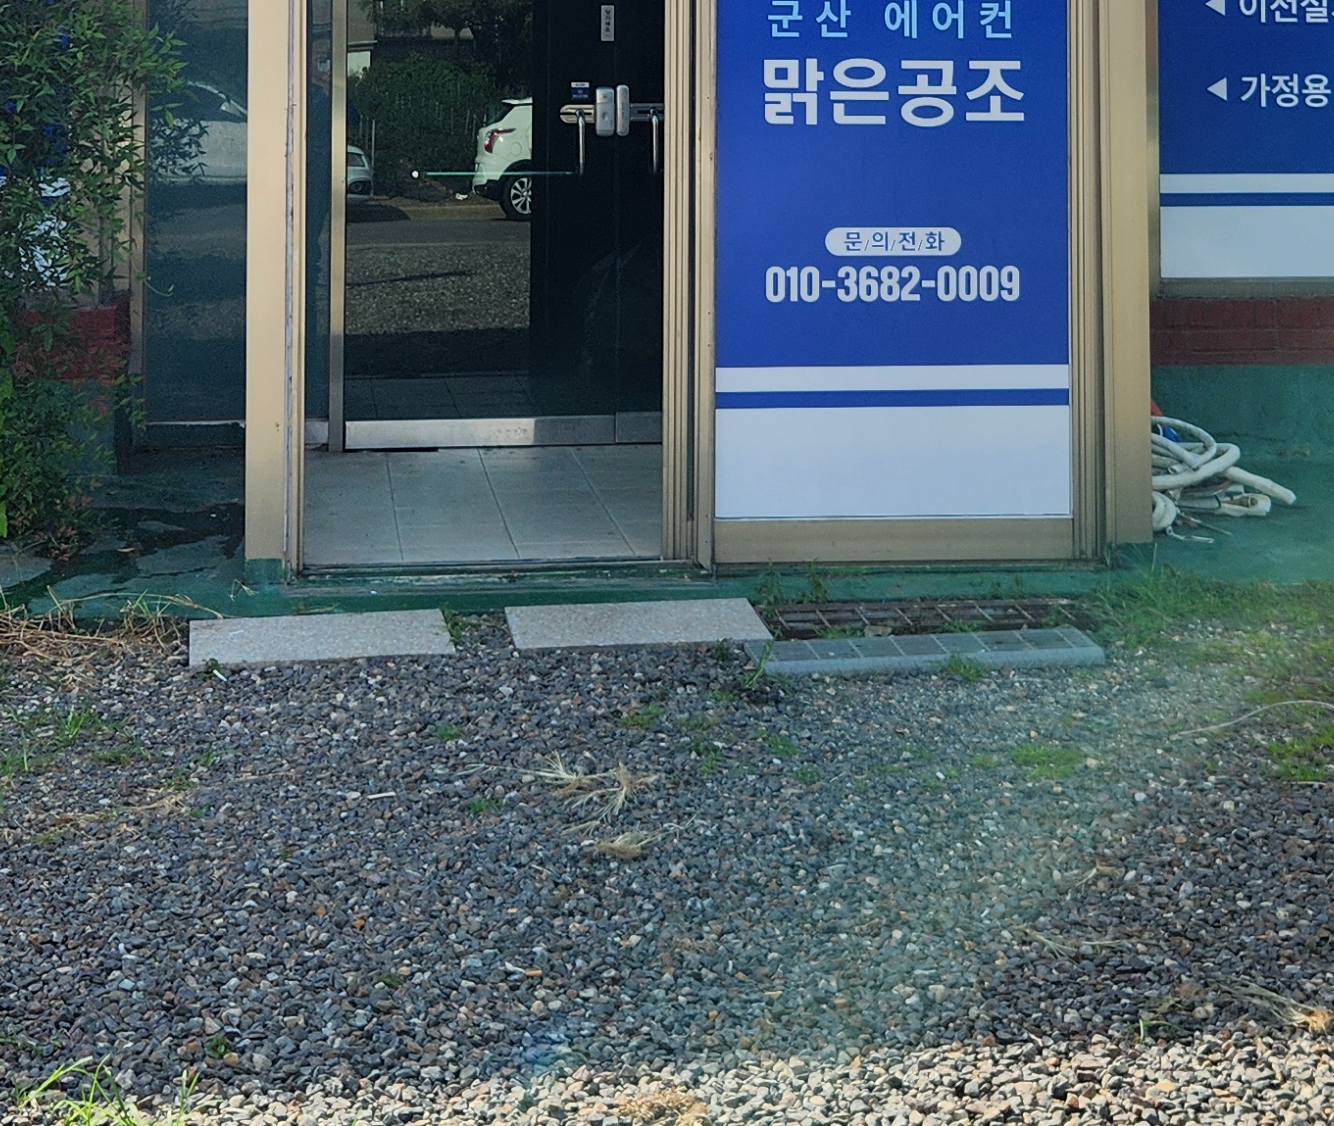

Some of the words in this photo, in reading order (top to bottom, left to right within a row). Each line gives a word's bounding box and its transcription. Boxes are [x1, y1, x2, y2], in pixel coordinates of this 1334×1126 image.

[767, 0, 852, 38] 군산
[884, 0, 1013, 39] 에어컨
[763, 58, 1024, 127] 맑은공조
[766, 265, 1020, 302] 010-3682-0009
